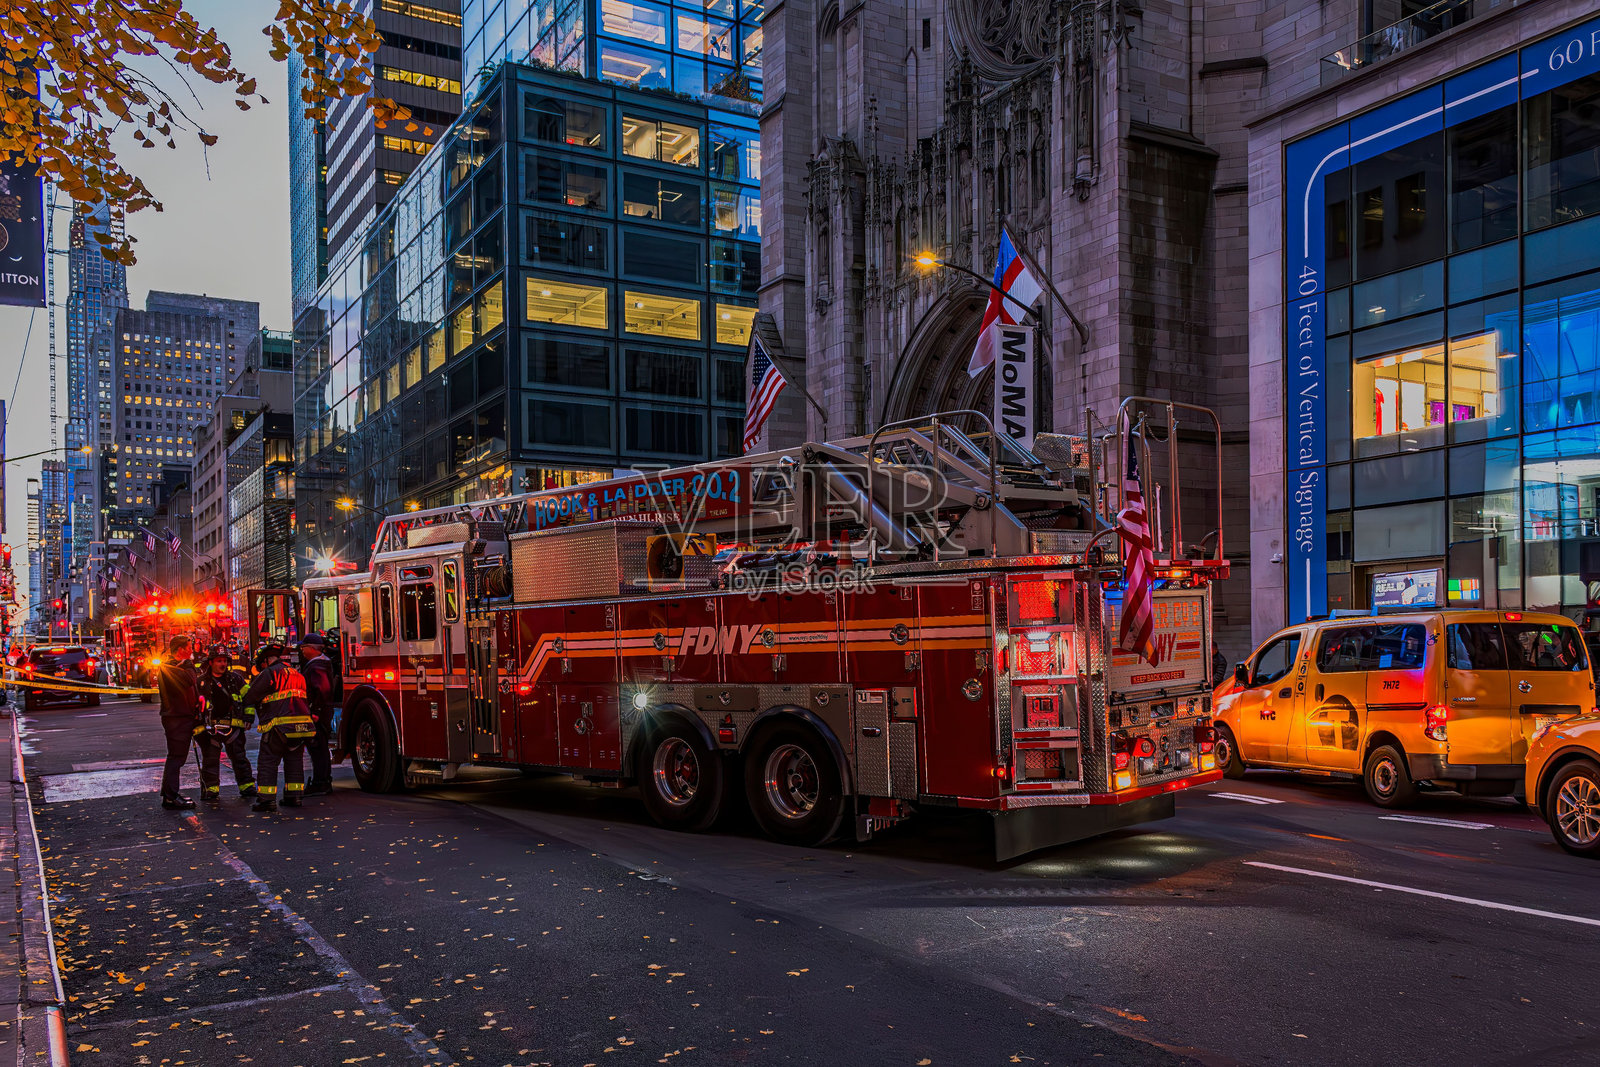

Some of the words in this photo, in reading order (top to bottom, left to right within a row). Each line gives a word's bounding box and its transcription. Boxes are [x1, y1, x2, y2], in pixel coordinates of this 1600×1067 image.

[1549, 39, 1583, 70] 60
[1, 272, 39, 285] ITTON
[1299, 265, 1318, 296] 40
[1299, 301, 1318, 349] Feet
[1299, 355, 1319, 377] of
[1002, 330, 1026, 440] MoMA
[1299, 382, 1319, 466] Vertical
[535, 493, 583, 531] HOOK
[588, 492, 599, 507] &
[1294, 471, 1319, 553] Signage
[678, 623, 763, 656] FDNY
[416, 665, 428, 695] 2
[1382, 680, 1401, 690] 7H72
[1259, 710, 1277, 721] NYC
